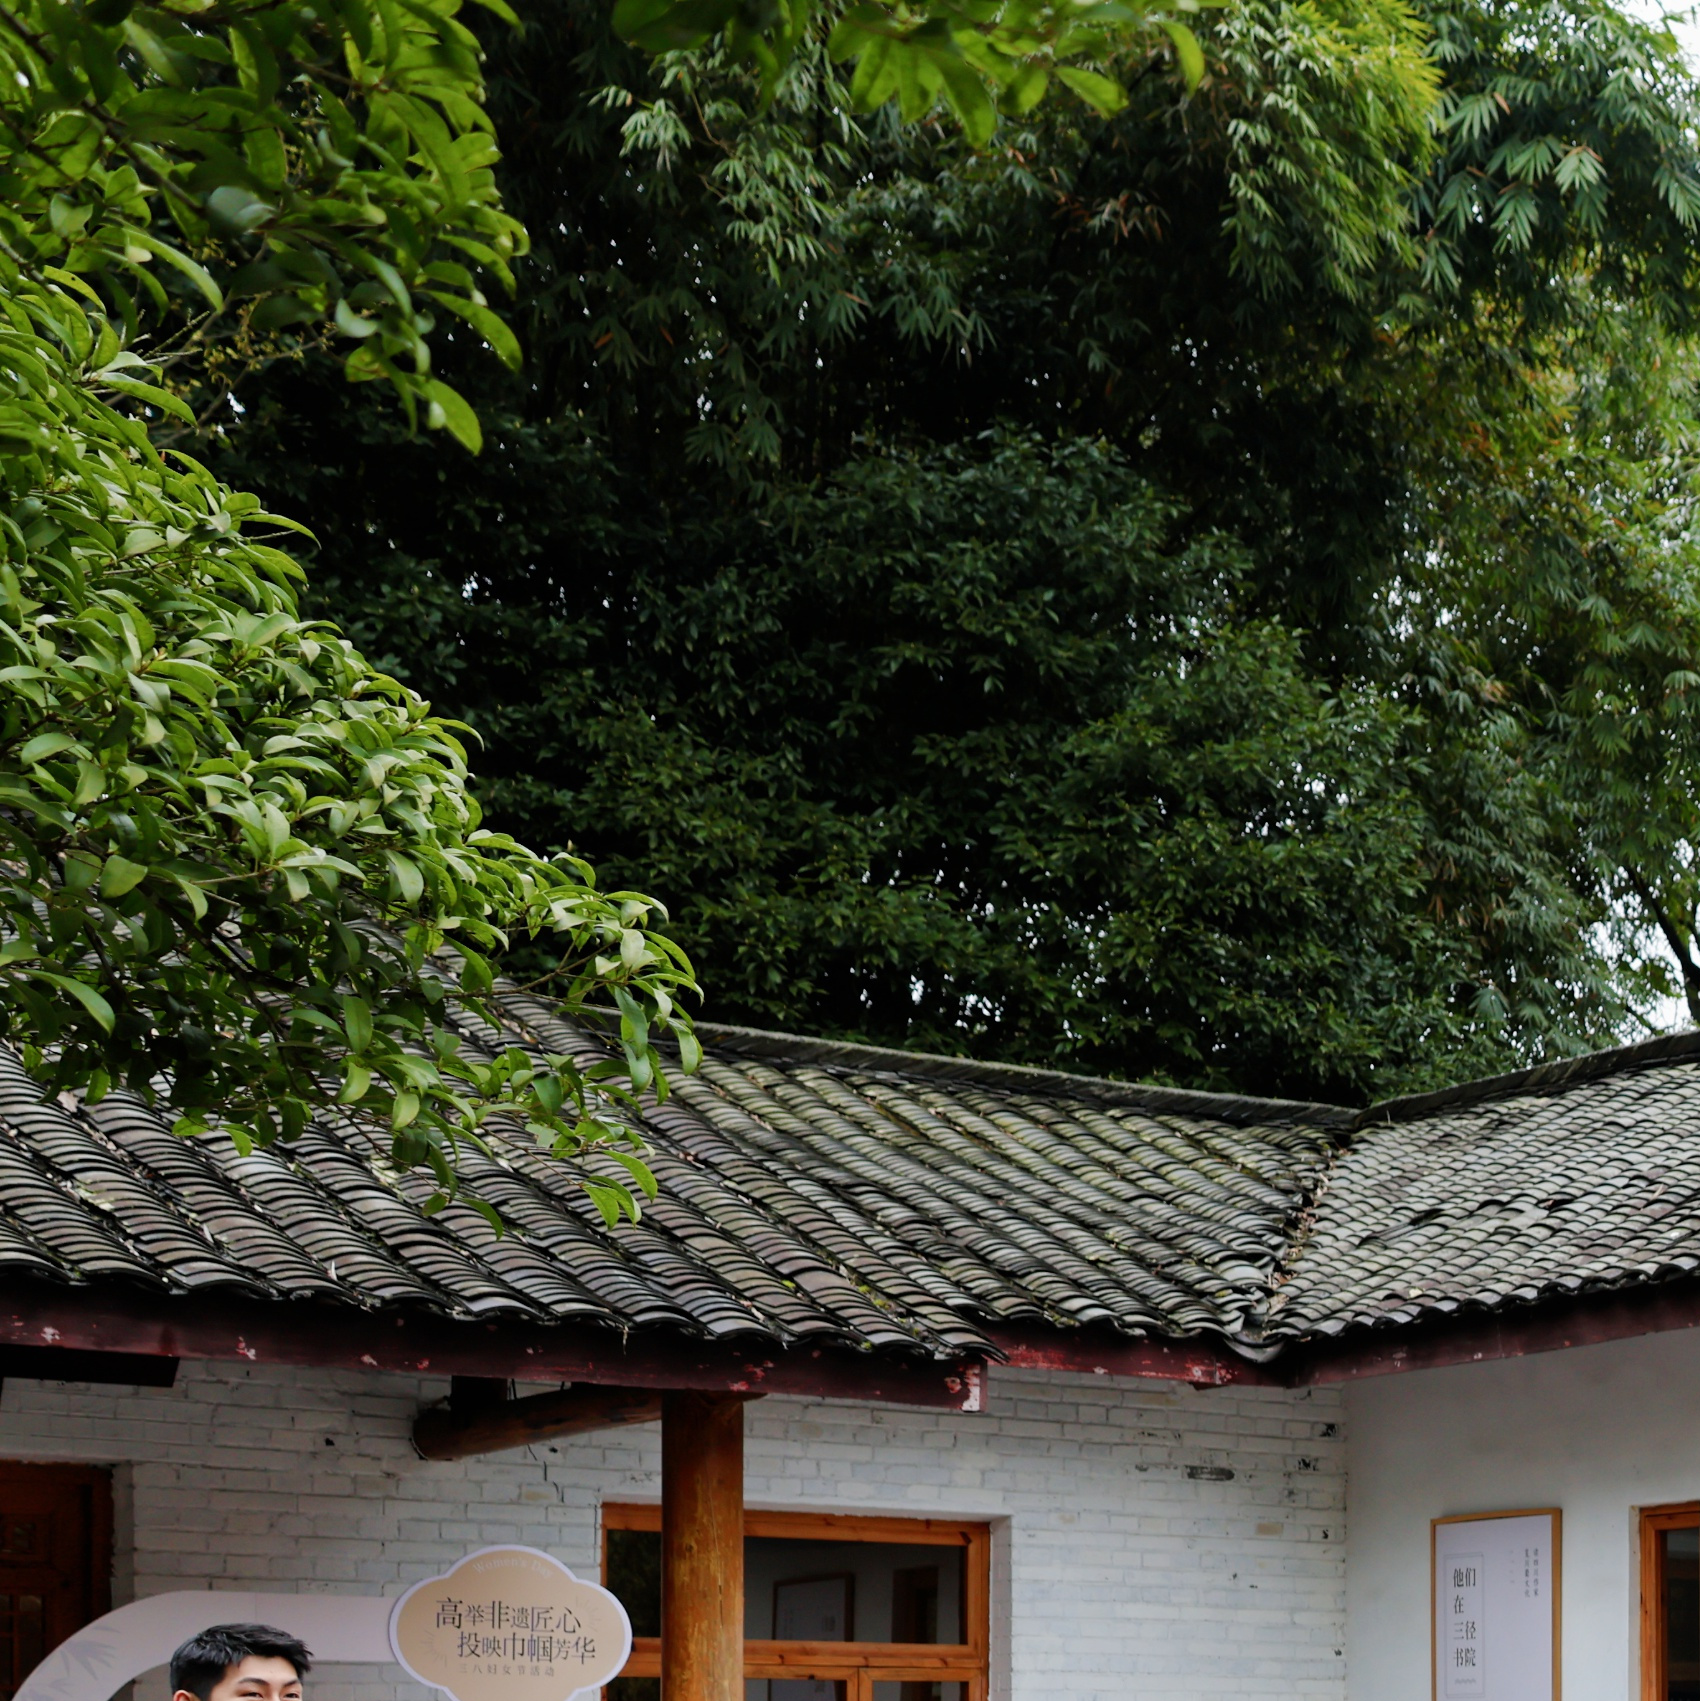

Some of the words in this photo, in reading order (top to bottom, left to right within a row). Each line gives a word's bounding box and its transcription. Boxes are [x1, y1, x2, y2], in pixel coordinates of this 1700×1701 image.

[472, 1556, 529, 1574] Women's
[1453, 1568, 1476, 1588] 他们
[1454, 1594, 1464, 1614] 在
[436, 1597, 582, 1634] 高举非遗匠心
[1453, 1621, 1476, 1640] 三径
[457, 1631, 596, 1665] 投映巾帼芳华
[1453, 1648, 1476, 1668] 书院
[458, 1664, 555, 1677] 三八妇女节活动
